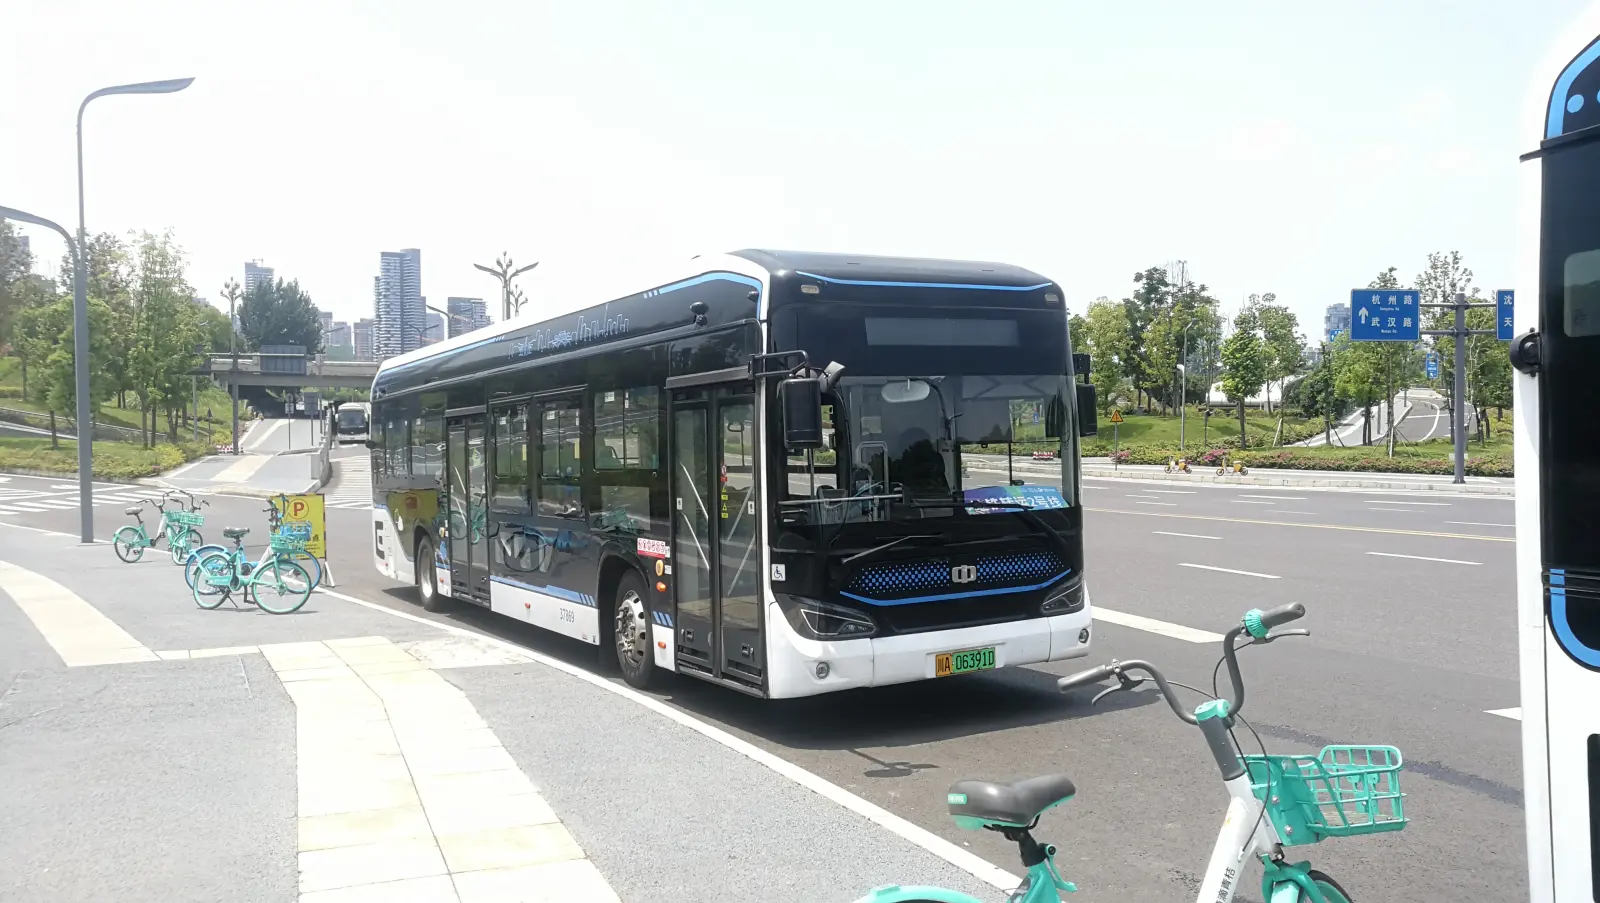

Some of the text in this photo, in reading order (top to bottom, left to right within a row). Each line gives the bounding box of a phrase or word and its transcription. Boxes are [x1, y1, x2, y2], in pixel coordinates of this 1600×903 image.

[1371, 294, 1413, 306] 杭州路
[1503, 294, 1513, 305] 沈
[1370, 316, 1413, 328] 武汉路
[1503, 317, 1513, 327] 天
[293, 501, 305, 517] P
[559, 607, 575, 623] 37869
